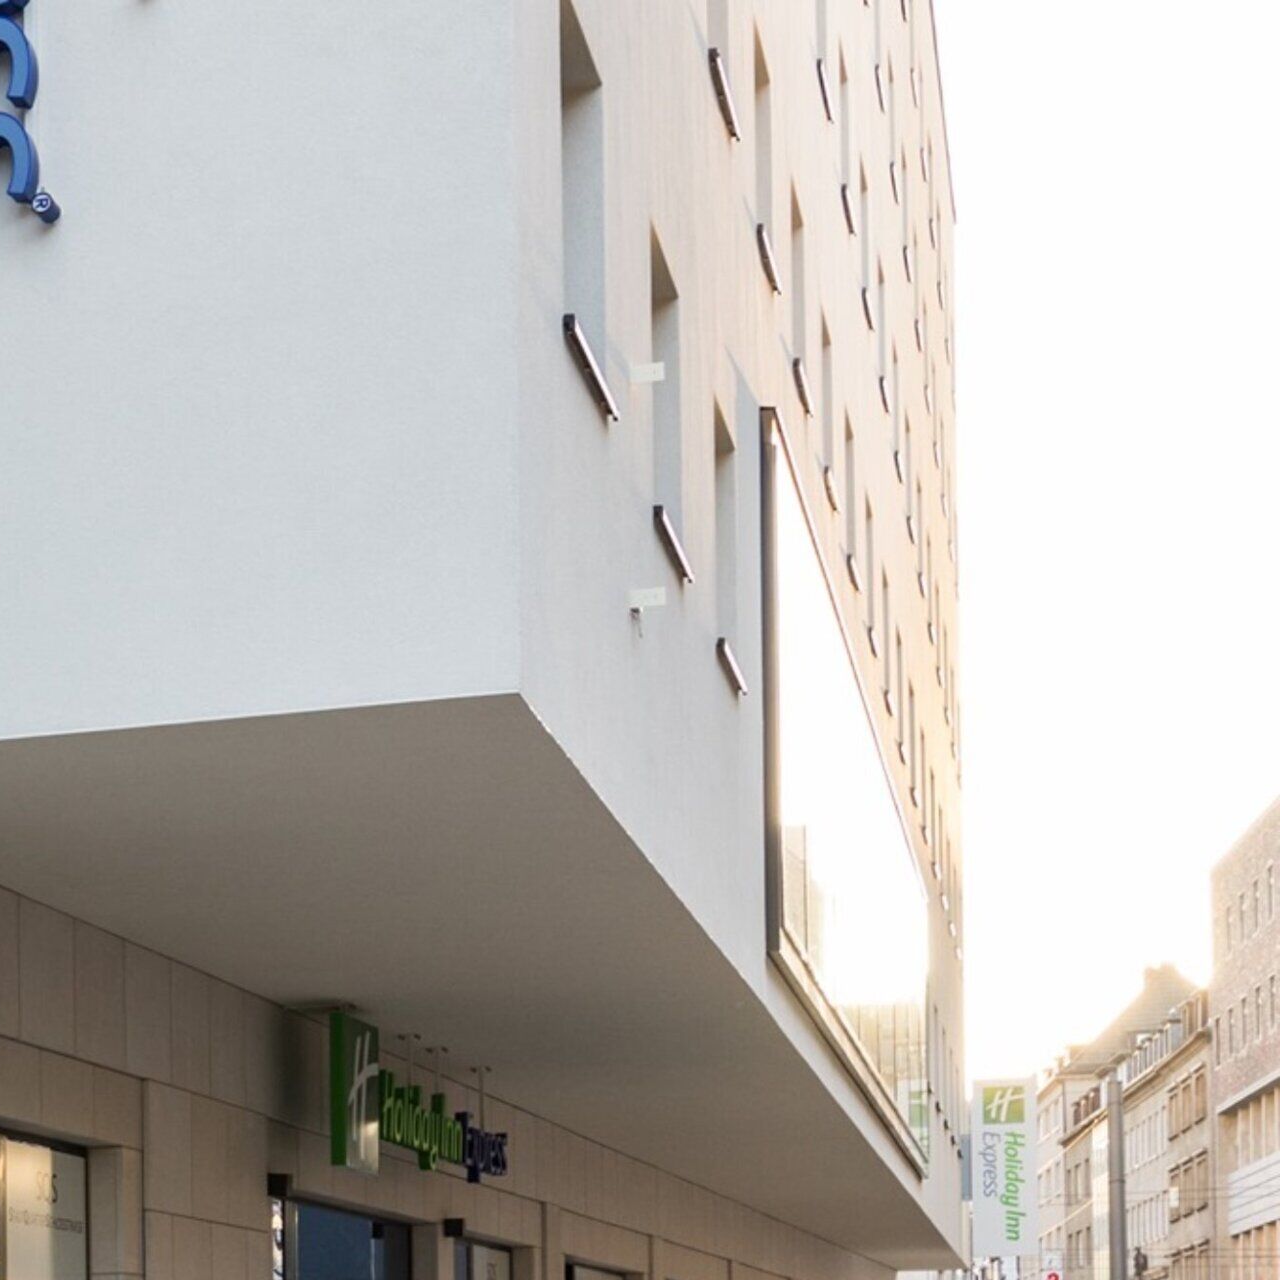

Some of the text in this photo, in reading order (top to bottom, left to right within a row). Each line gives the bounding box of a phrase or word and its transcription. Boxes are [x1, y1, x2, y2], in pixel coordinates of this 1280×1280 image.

[978, 1131, 1001, 1198] Express
[1000, 1131, 1026, 1242] Holiday Inn
